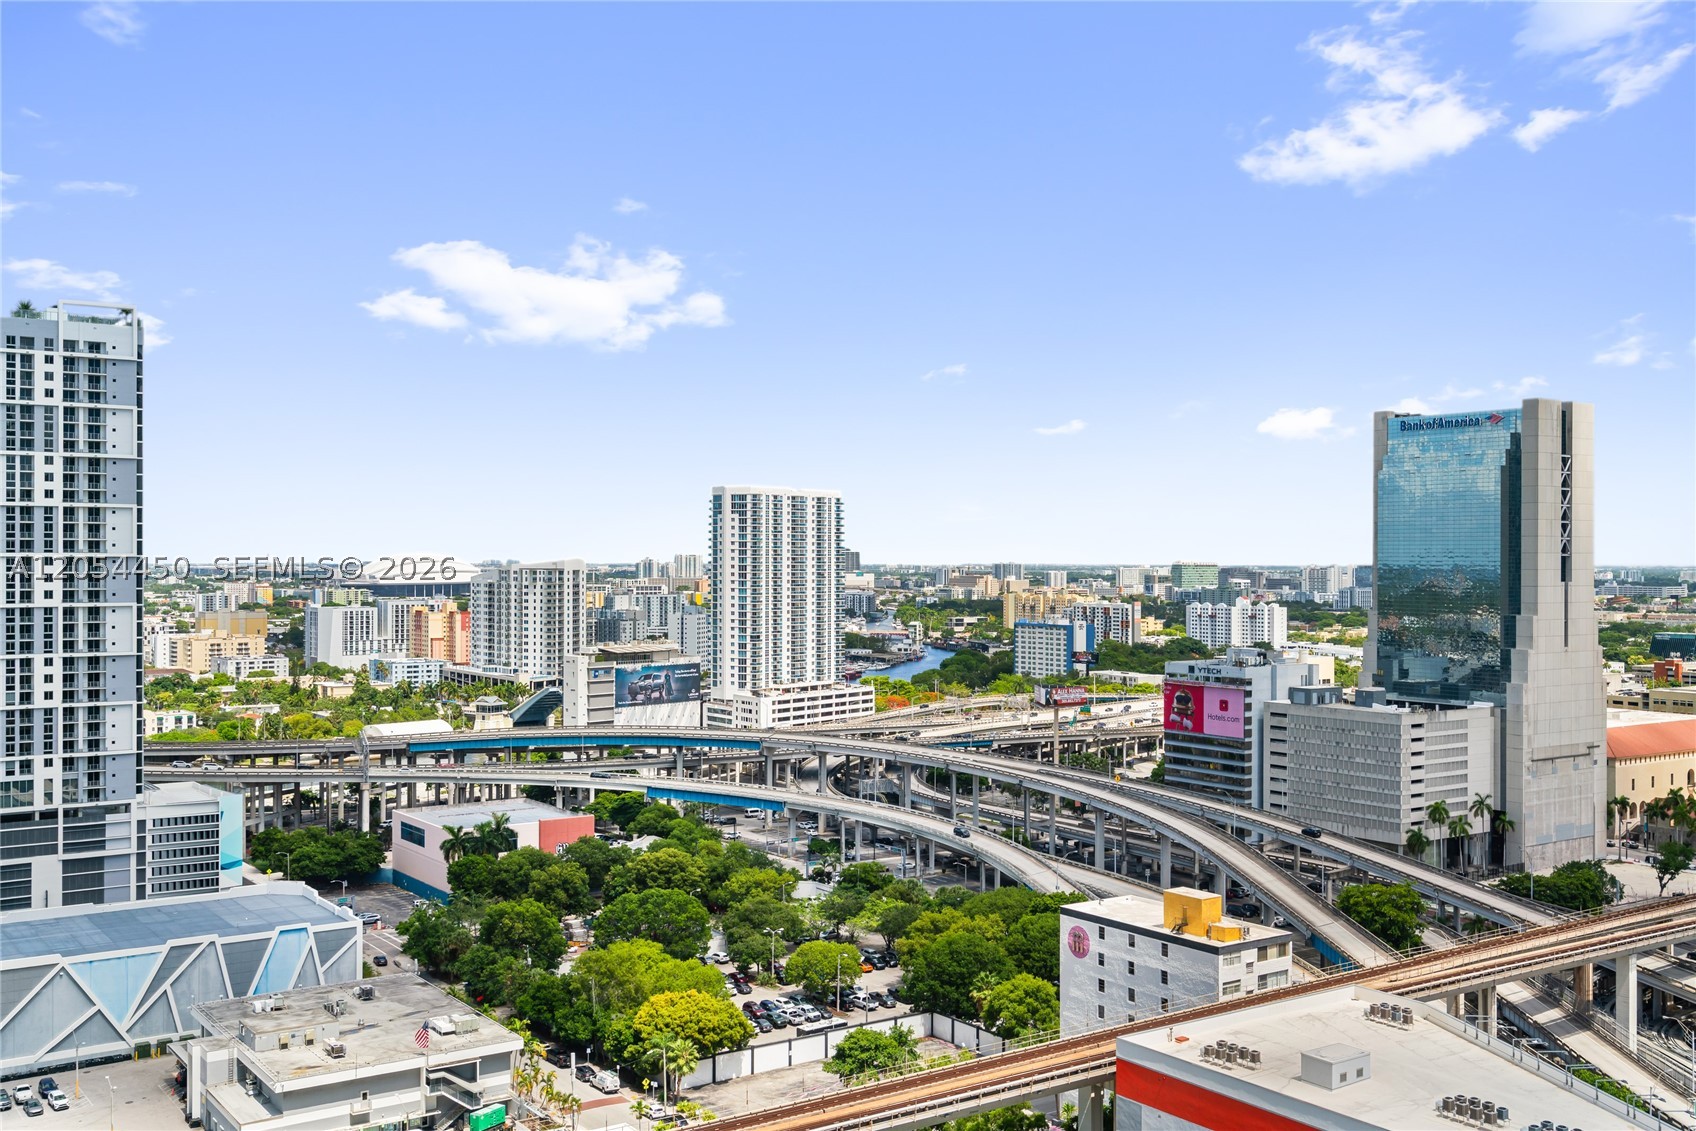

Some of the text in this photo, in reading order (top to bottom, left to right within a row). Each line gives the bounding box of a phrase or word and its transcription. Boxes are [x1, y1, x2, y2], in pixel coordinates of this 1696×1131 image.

[1400, 416, 1481, 431] Bank of America
[1197, 666, 1222, 675] YTECH
[1207, 713, 1240, 723] Hotels.com
